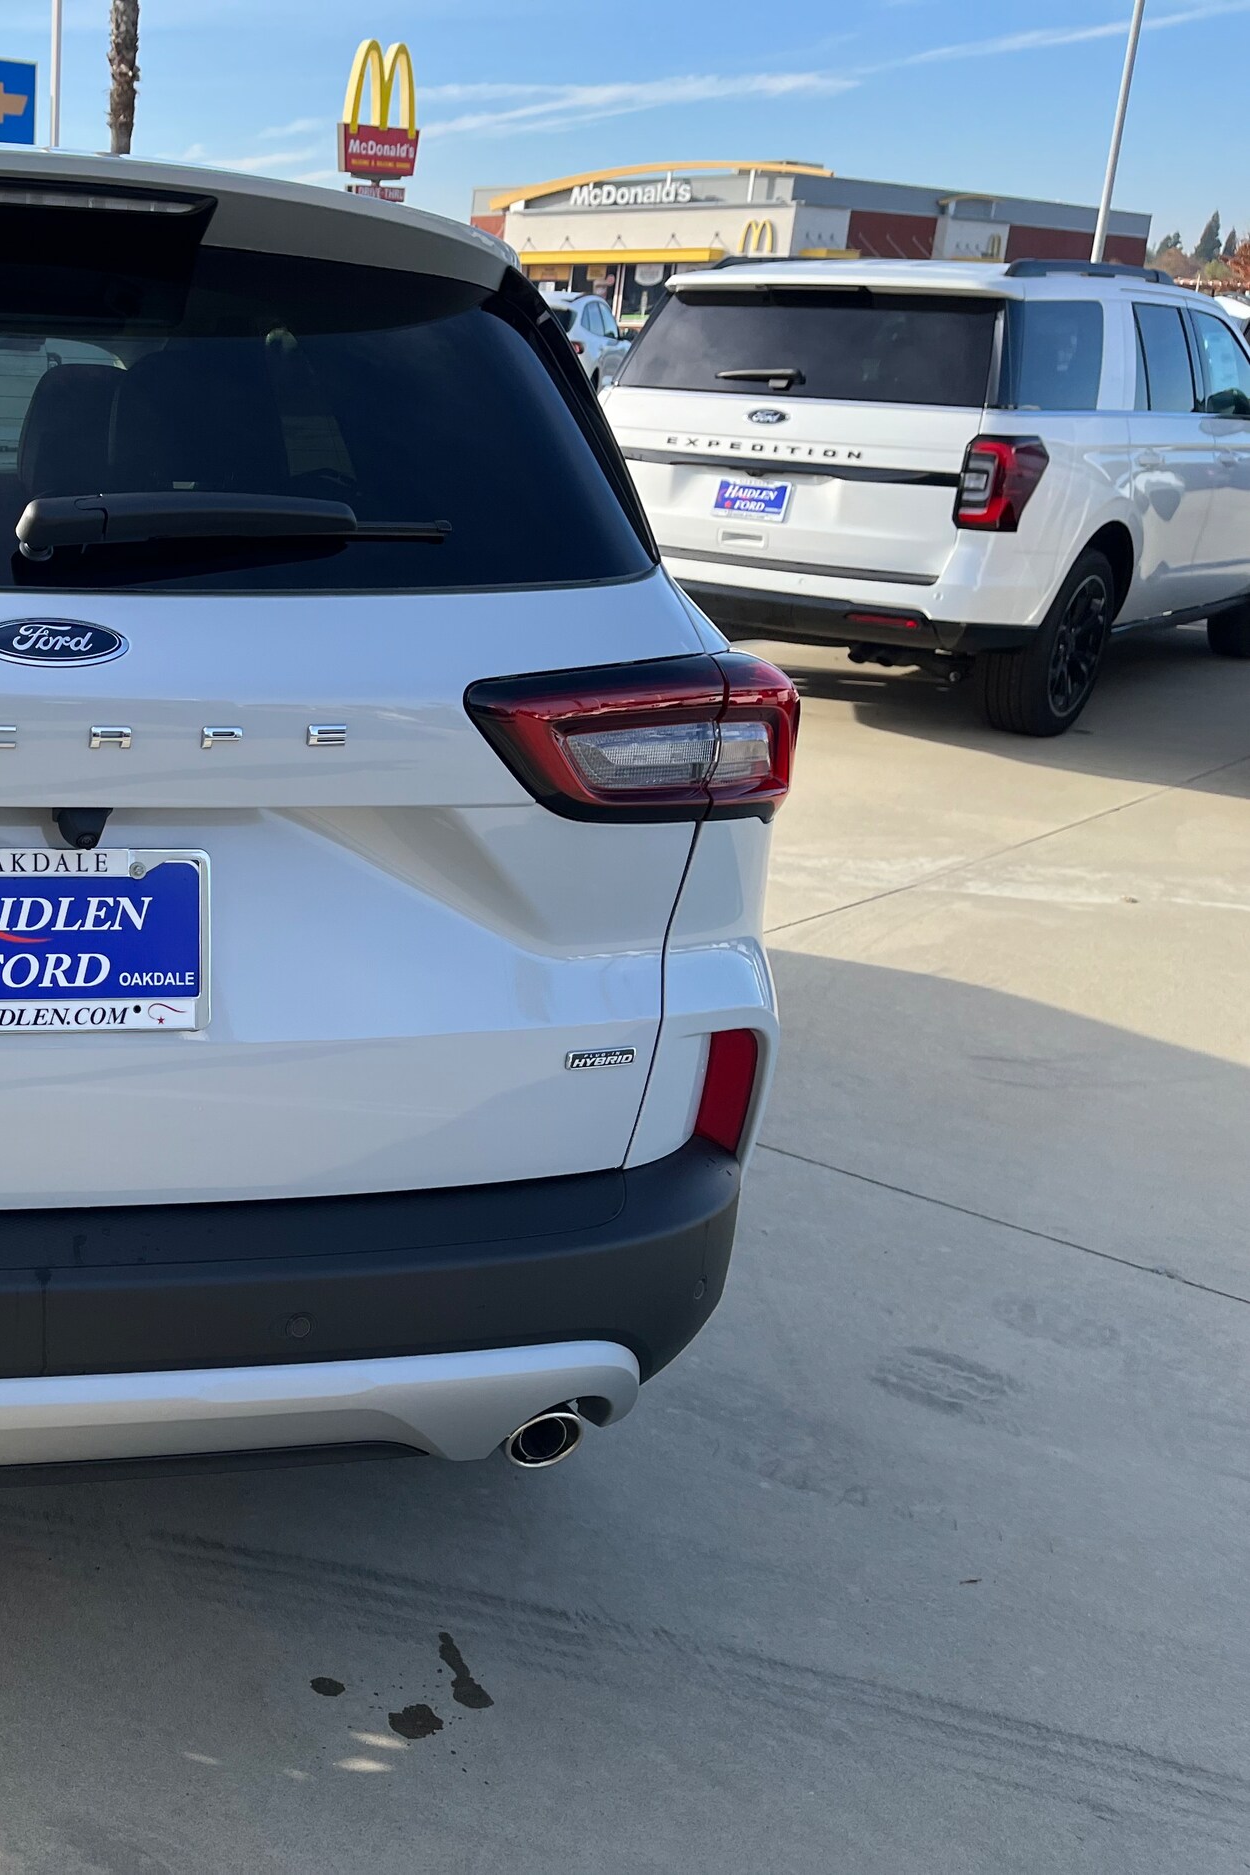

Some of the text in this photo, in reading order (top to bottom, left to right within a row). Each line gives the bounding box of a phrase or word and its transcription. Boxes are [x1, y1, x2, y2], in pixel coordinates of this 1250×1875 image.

[348, 139, 415, 158] McDonald's
[570, 181, 692, 206] McDonald's
[666, 436, 864, 460] EXPEDITION
[724, 484, 779, 501] HAIDLEN
[733, 499, 766, 512] FORD
[11, 622, 93, 653] Ford
[118, 971, 196, 987] OAKDALE
[572, 1054, 633, 1068] HYBRID
